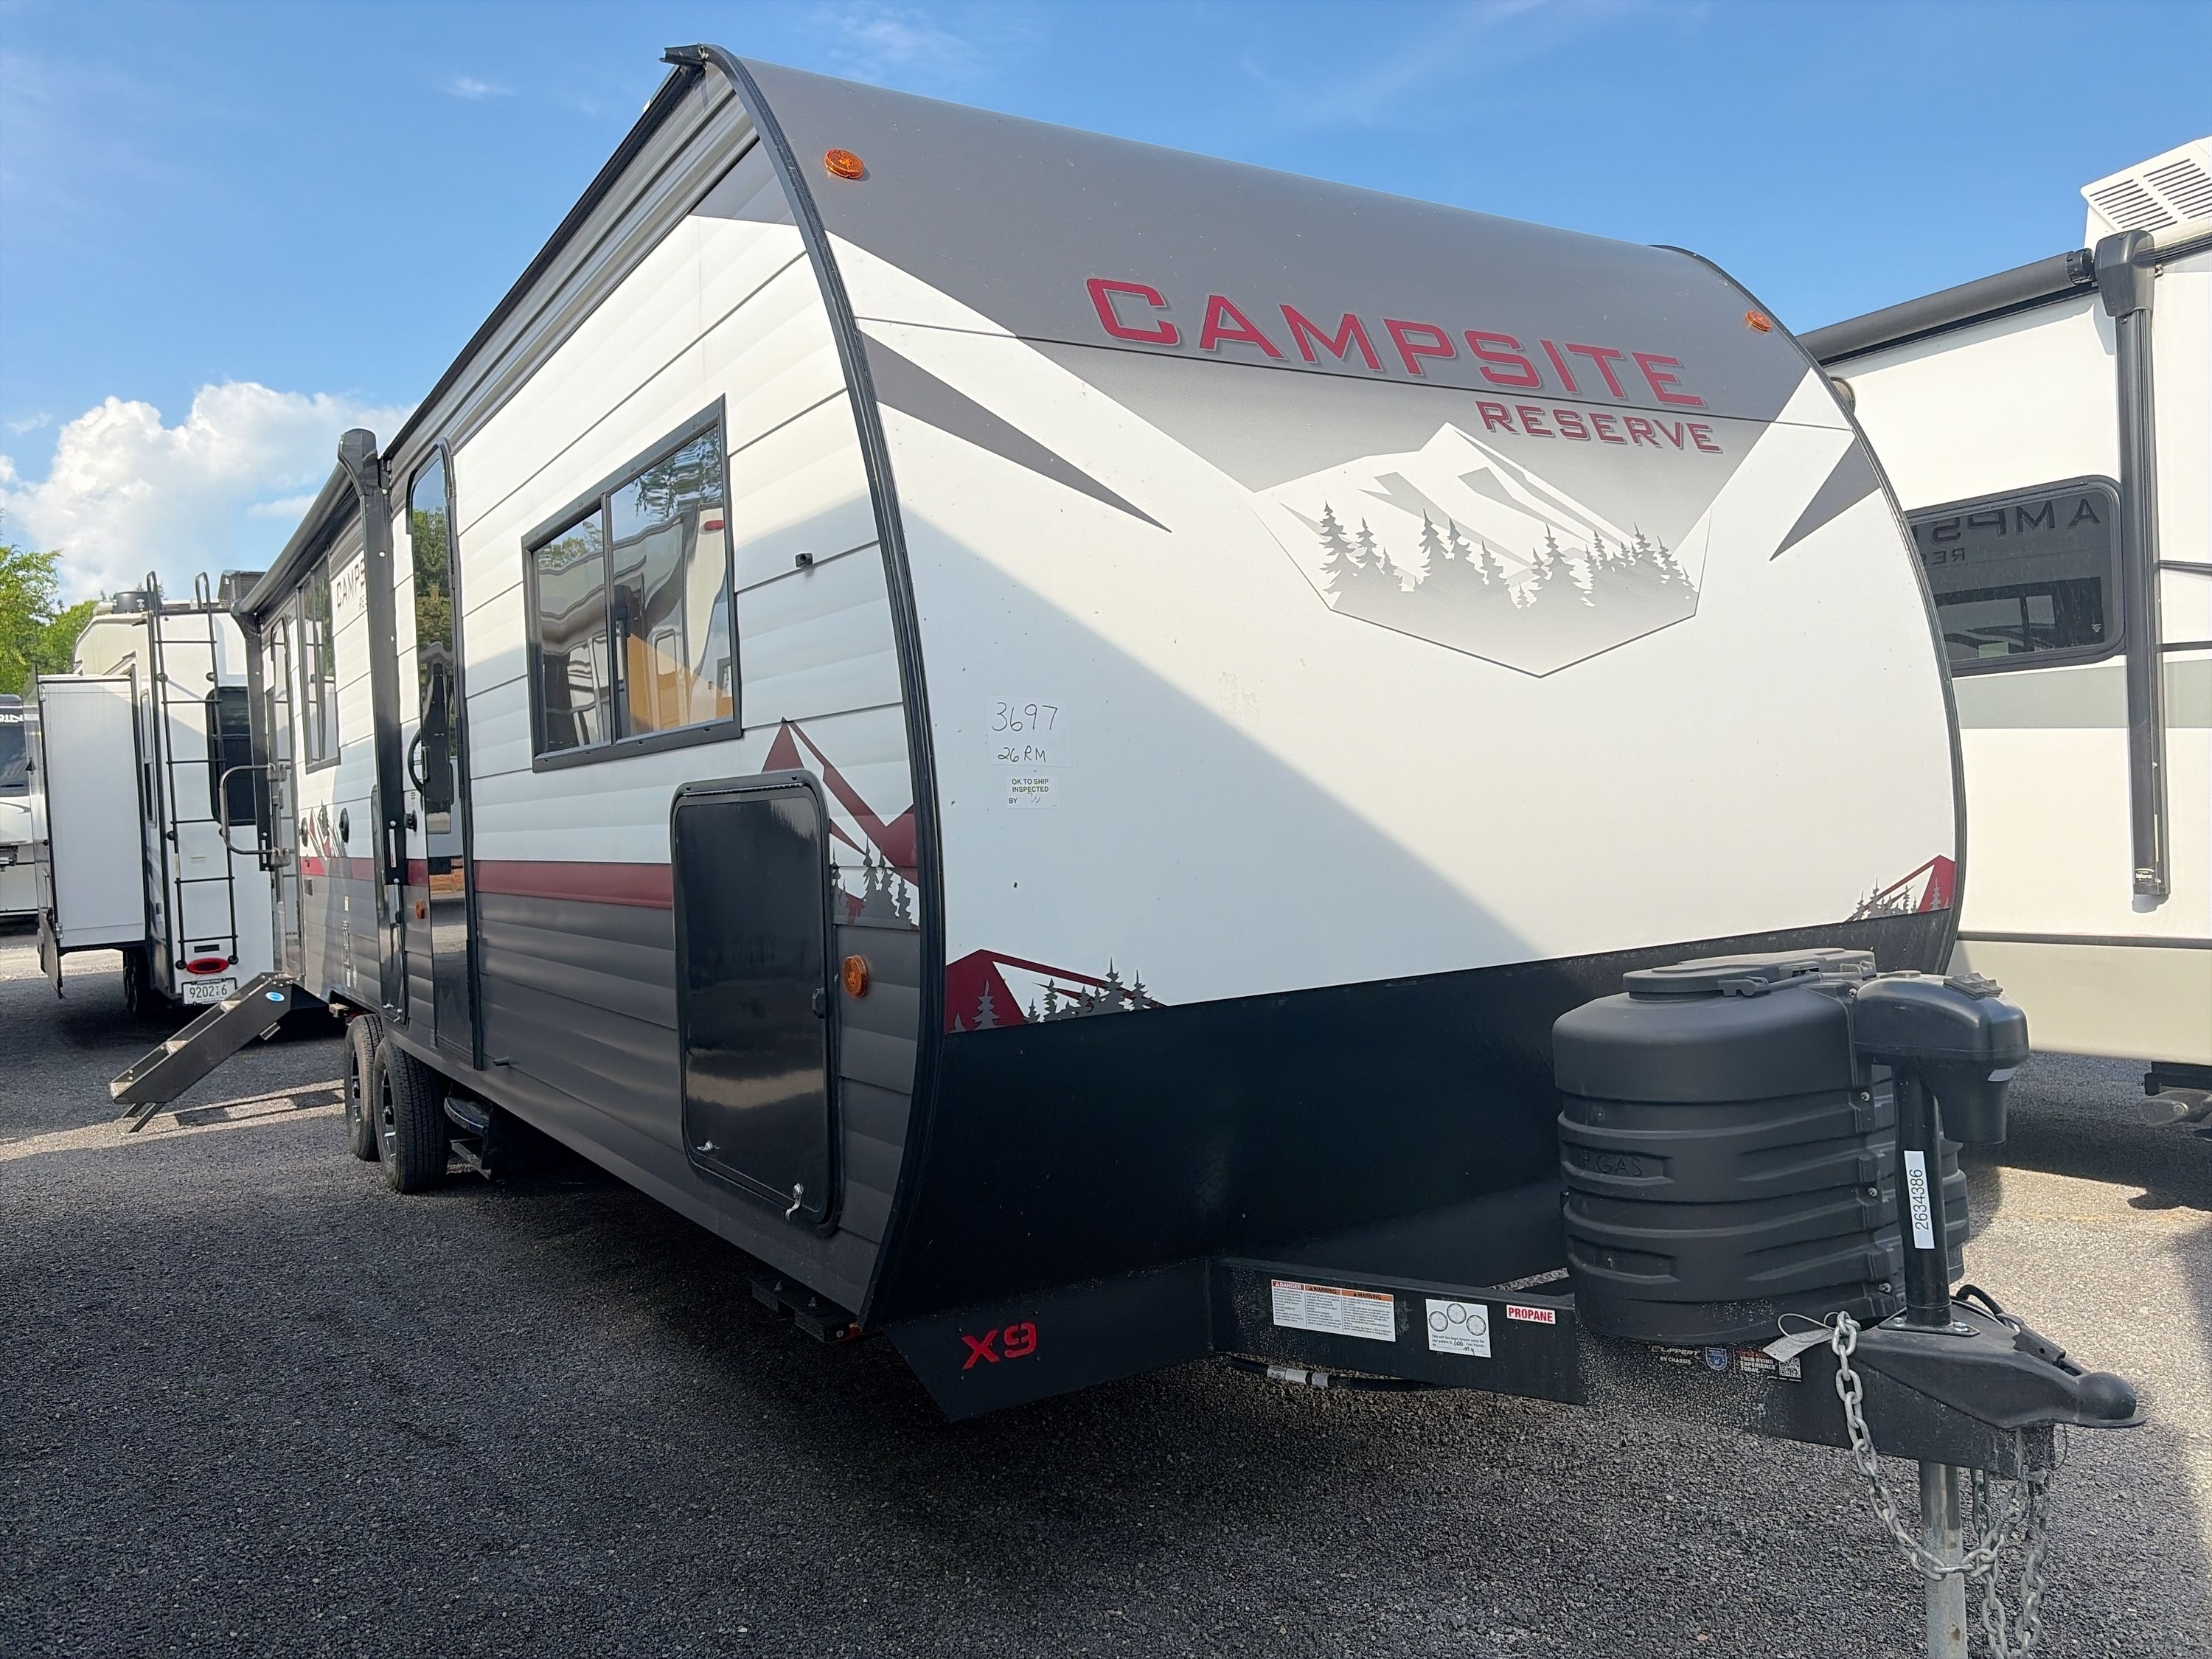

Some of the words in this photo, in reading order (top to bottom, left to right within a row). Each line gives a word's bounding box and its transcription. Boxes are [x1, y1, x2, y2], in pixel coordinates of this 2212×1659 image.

[1086, 278, 1706, 407] CAMPSITE
[1475, 400, 1724, 453] RESERVE
[992, 701, 1058, 732] 3697
[1596, 1154, 1643, 1178] GAS
[1908, 1169, 1930, 1231] 2634386
[1357, 1292, 1382, 1300] WARNING
[1508, 1307, 1554, 1322] PROPANE
[961, 1322, 1037, 1370] X9
[1739, 1361, 1776, 1370] EXPERIENCE
